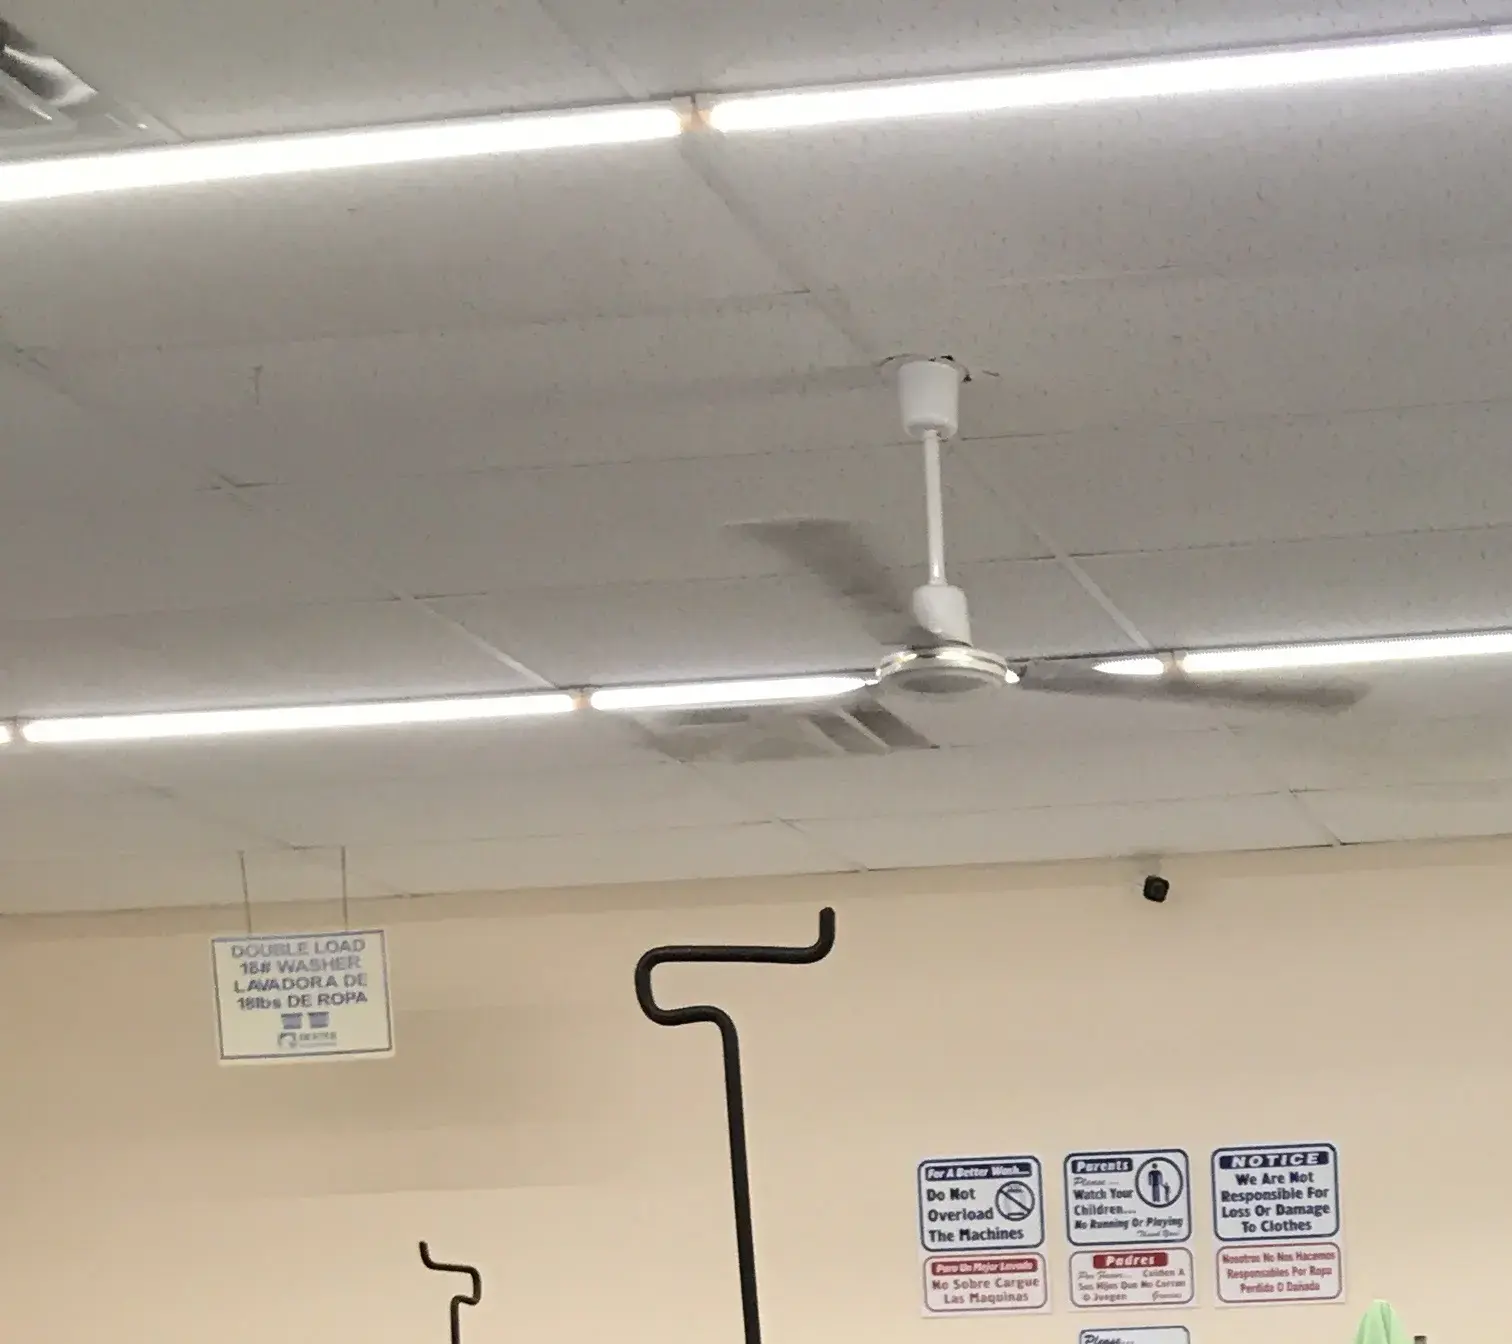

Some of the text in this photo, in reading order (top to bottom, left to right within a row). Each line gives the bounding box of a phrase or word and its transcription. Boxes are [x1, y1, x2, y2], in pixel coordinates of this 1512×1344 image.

[231, 939, 365, 958] DOUBLE LOAD
[278, 956, 361, 973] WASHER
[234, 973, 367, 993] LAVADORA DE
[288, 995, 312, 1007] DE
[317, 992, 368, 1007] ROPA
[1077, 1161, 1129, 1172] Parents
[1232, 1153, 1319, 1168] NOTICE
[928, 1169, 945, 1178] For
[946, 1169, 954, 1178] A
[1235, 1171, 1314, 1185] We Are Not
[927, 1188, 976, 1201] Do Not
[1073, 1188, 1133, 1200] Watch Your
[1221, 1187, 1329, 1204] Responsible For
[928, 1207, 994, 1221] Overload
[1222, 1204, 1330, 1218] Loss Or Damage
[1075, 1216, 1183, 1230] No Running Or Playing
[1242, 1219, 1312, 1233] To Clothes
[929, 1227, 1024, 1242] The Machines
[1105, 1255, 1155, 1266] Padres
[932, 1278, 1039, 1289] No Sobre Cargue
[944, 1294, 964, 1304] Las
